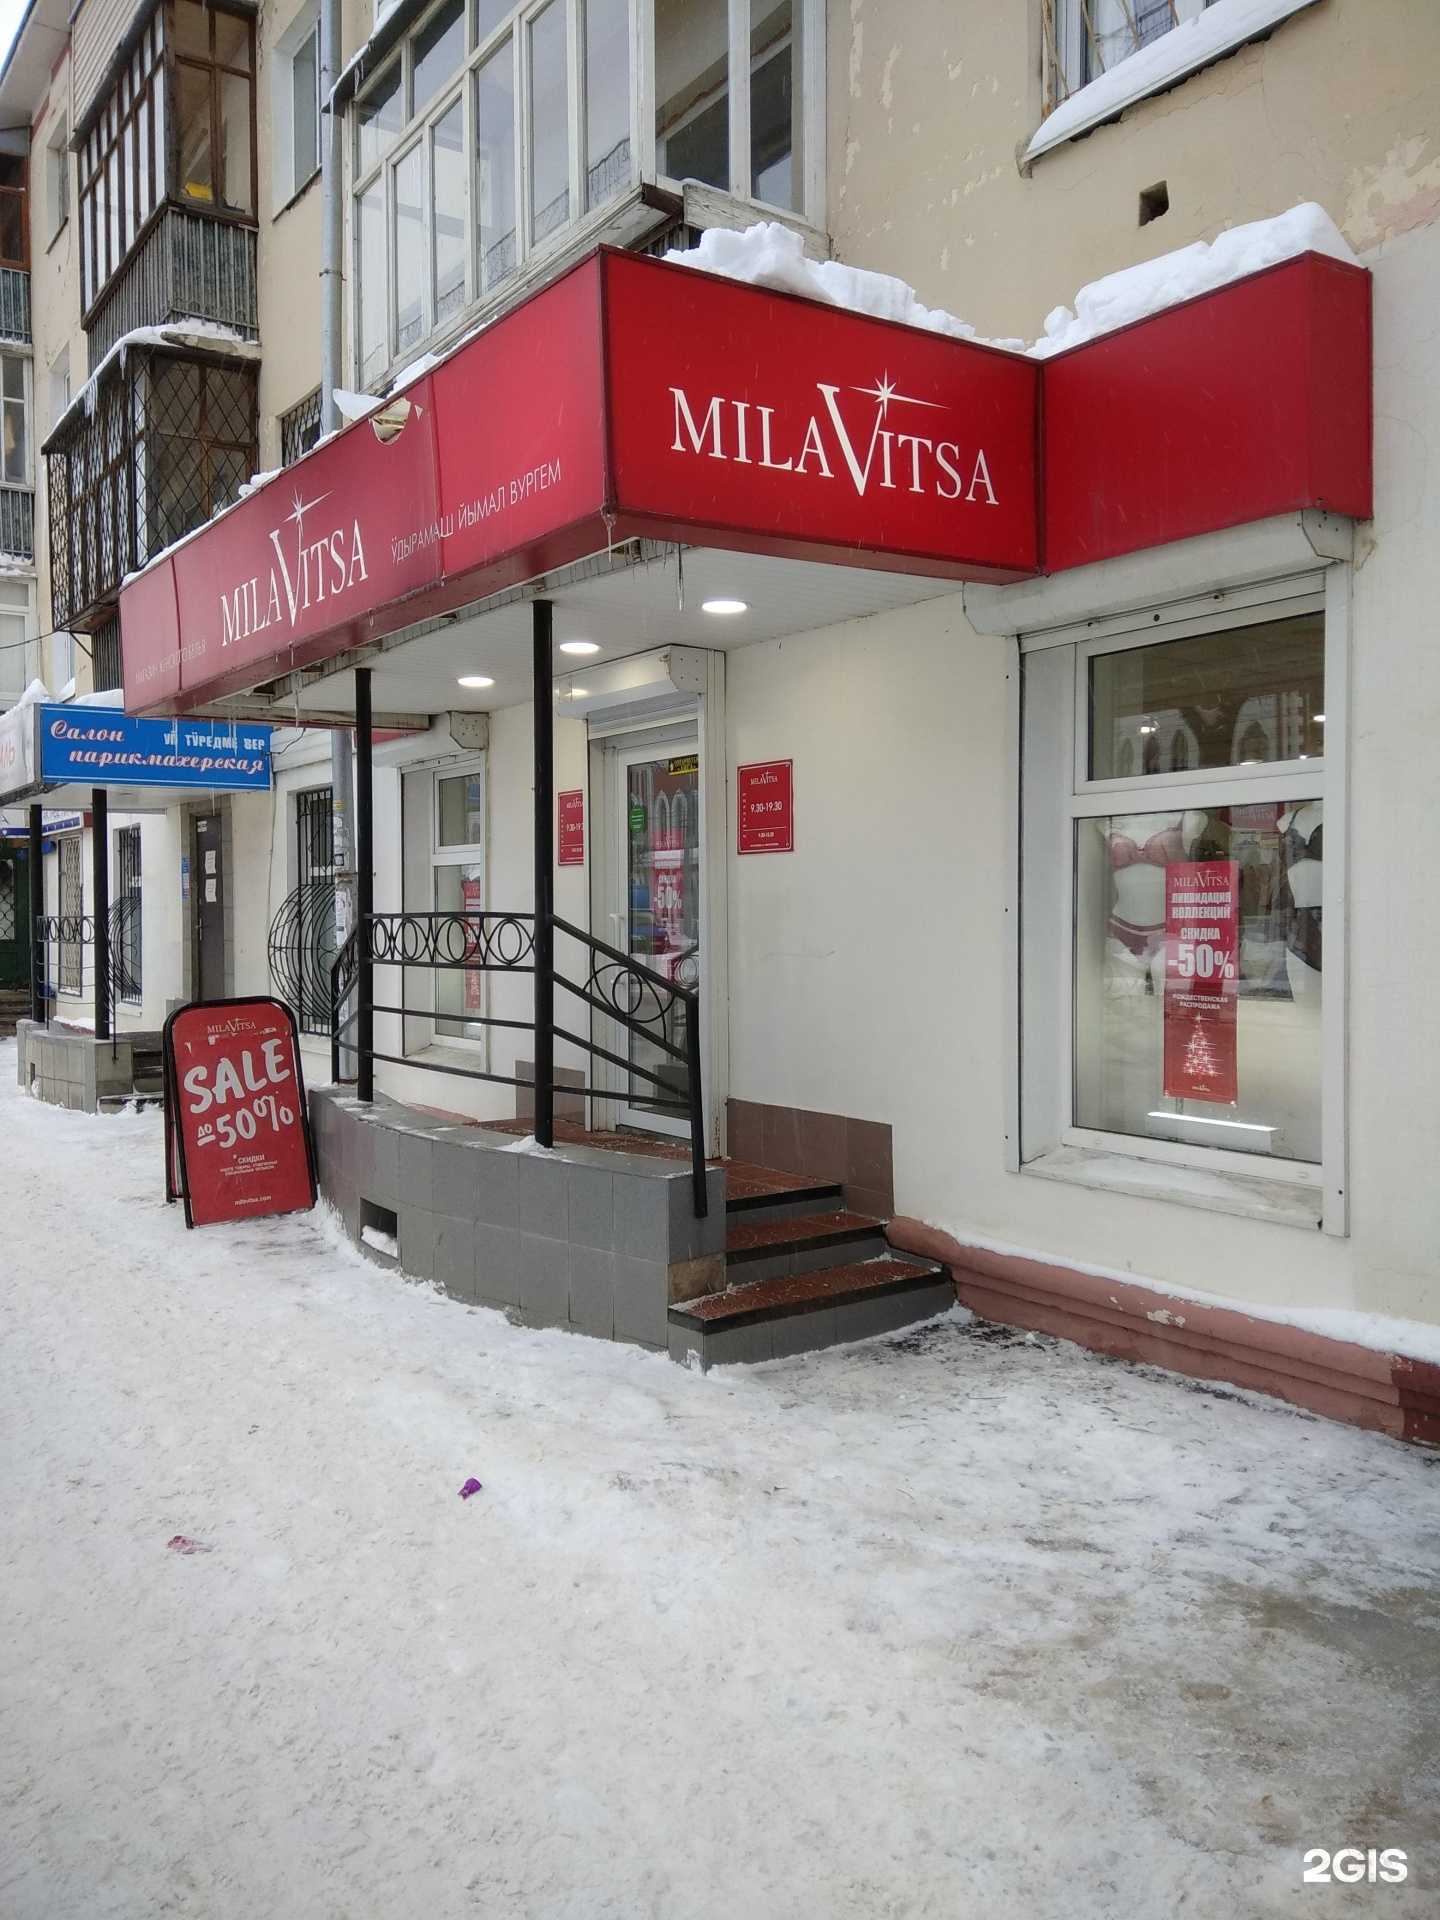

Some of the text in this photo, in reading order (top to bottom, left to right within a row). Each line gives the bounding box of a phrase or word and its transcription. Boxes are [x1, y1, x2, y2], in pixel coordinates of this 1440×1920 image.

[668, 382, 1000, 506] MILAVITSA
[458, 486, 505, 530] ЙЫМАЛ
[509, 457, 562, 505] ВУРГЕМ
[220, 518, 369, 647] MILAVITSA
[50, 719, 125, 742] Салон
[69, 748, 264, 775] парикмахерская
[1174, 871, 1230, 889] MILAVITSA
[1180, 927, 1221, 941] СКИДКА
[1168, 943, 1235, 979] -50%
[207, 1020, 257, 1034] MILAVITSA
[183, 1037, 291, 1115] SALE
[216, 1092, 294, 1149] 50%
